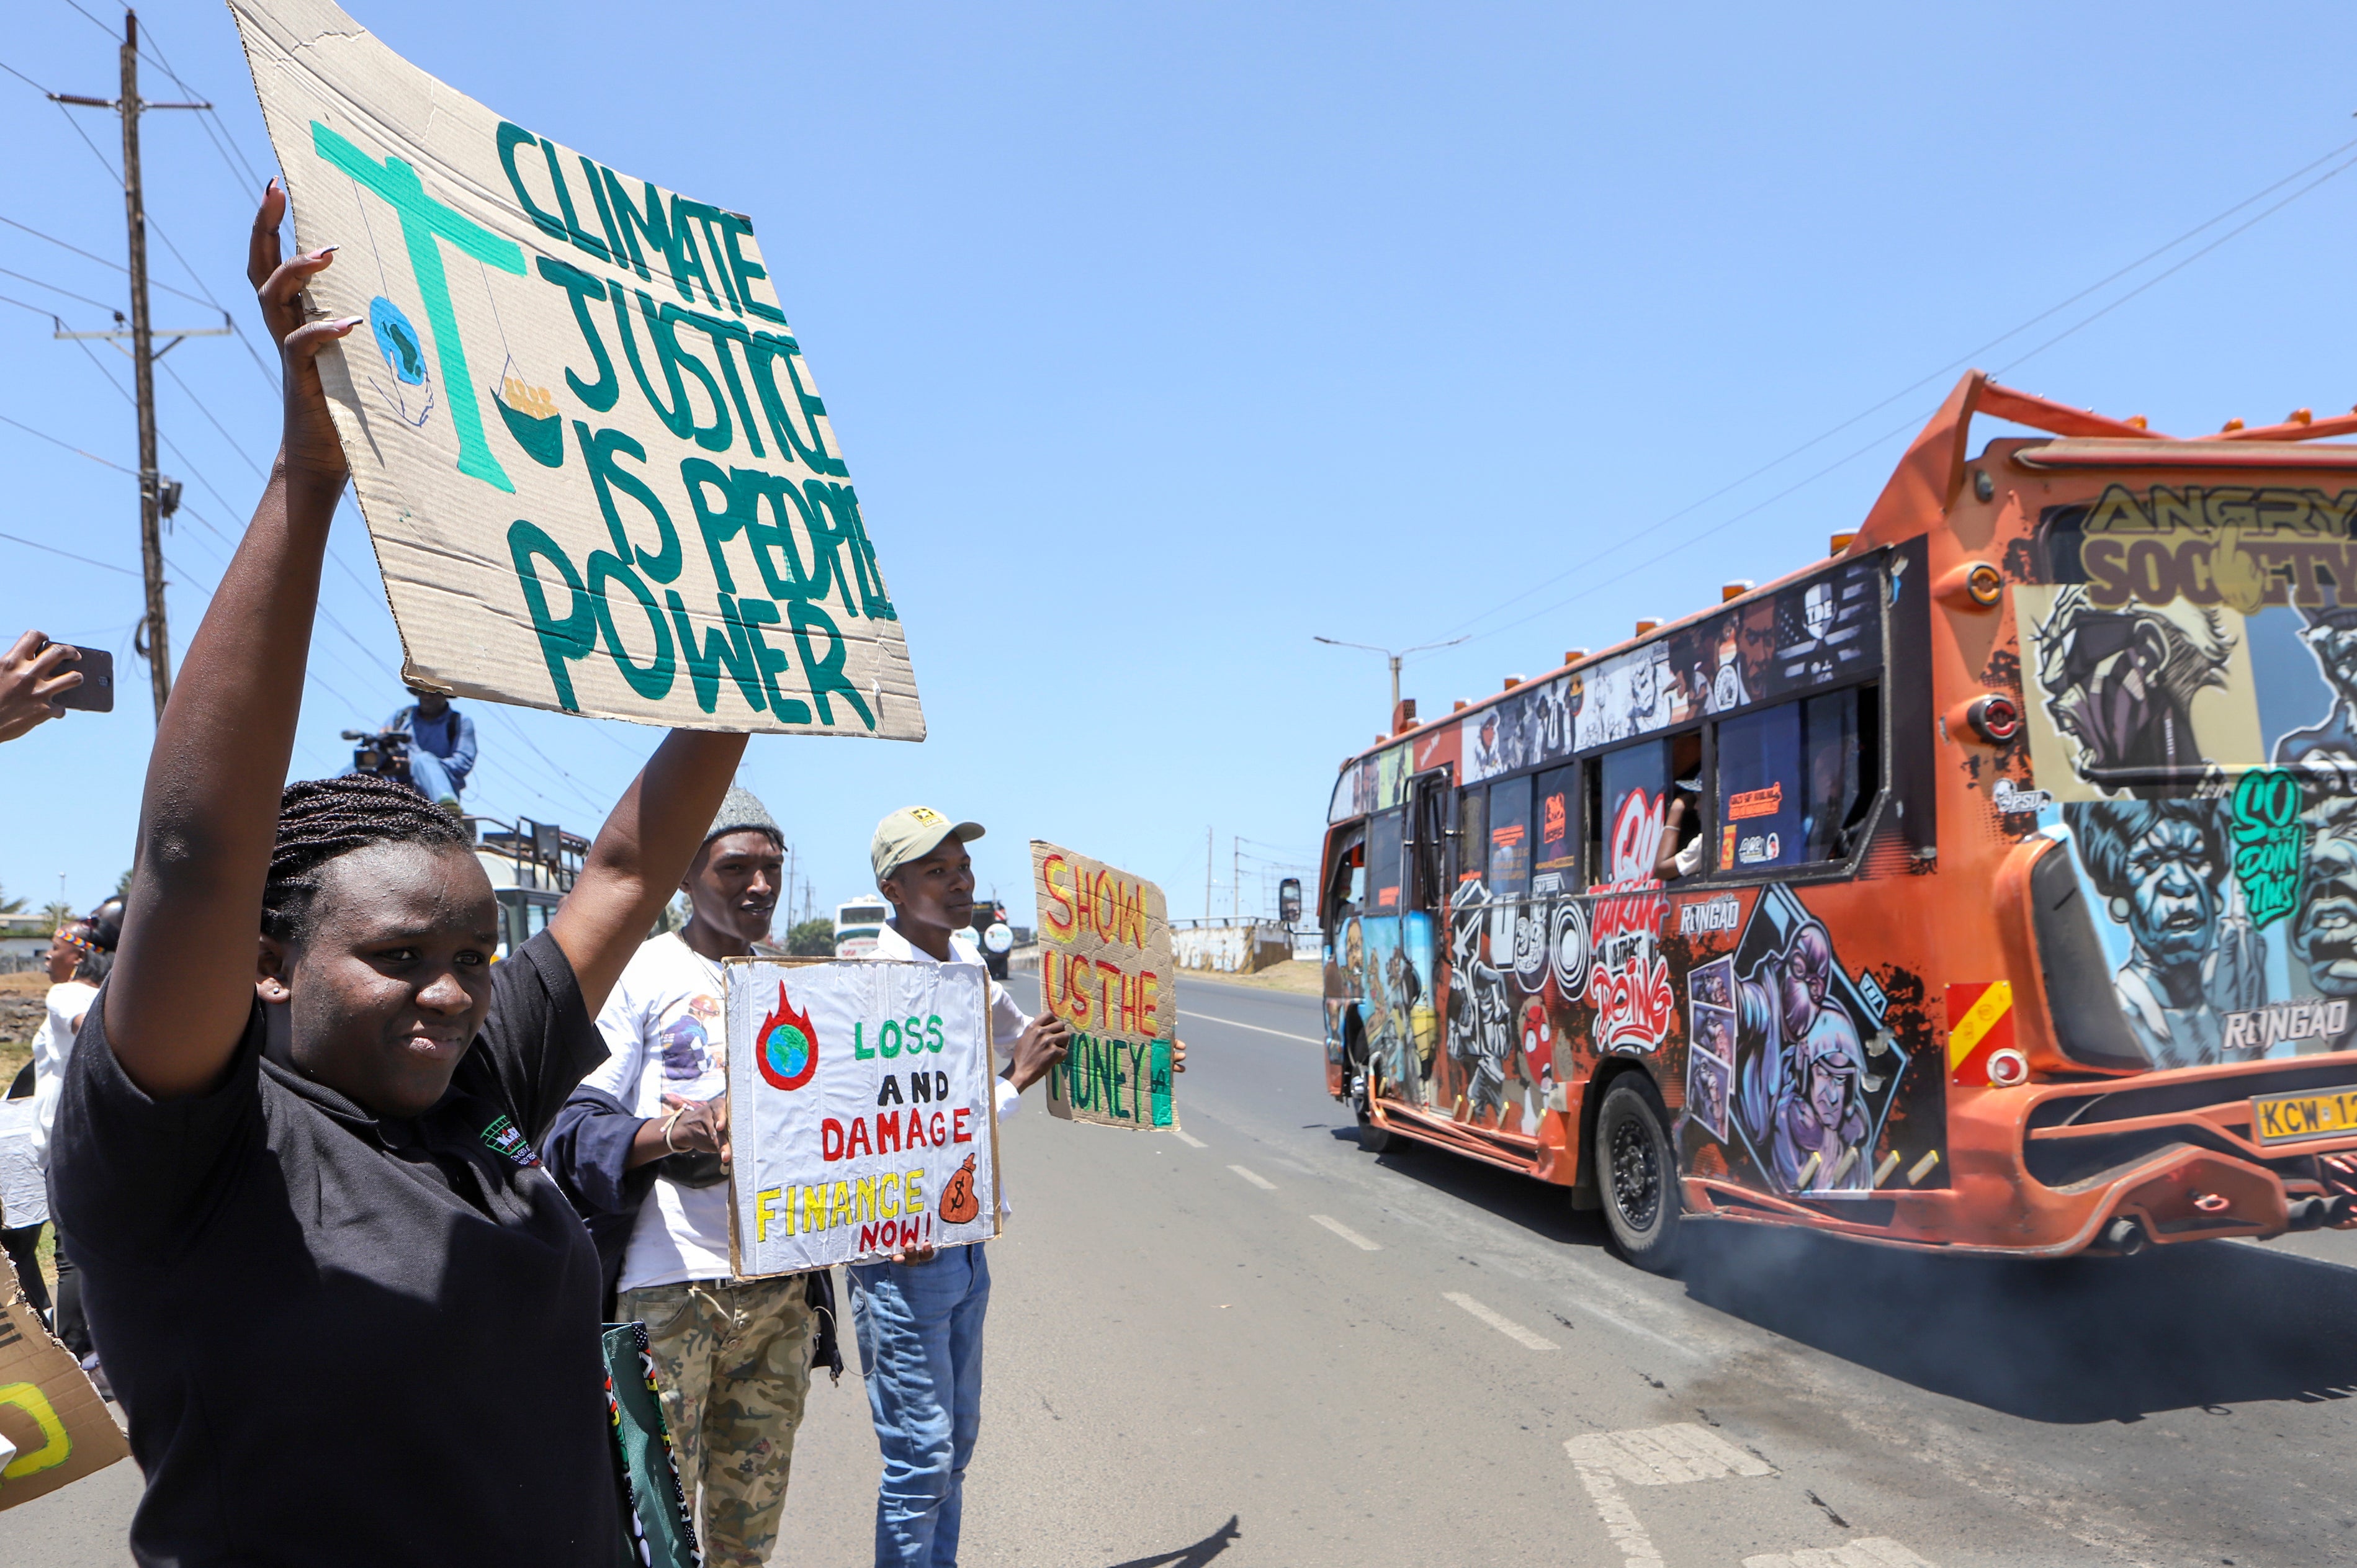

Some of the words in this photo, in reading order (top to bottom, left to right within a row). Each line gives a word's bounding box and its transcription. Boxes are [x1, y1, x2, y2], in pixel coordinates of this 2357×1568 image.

[496, 121, 788, 326] CLIMATE
[536, 255, 851, 477] JUSTICE
[572, 419, 683, 584] IS
[680, 457, 897, 620] PEOPLE
[2082, 483, 2357, 537] ANGRY
[506, 519, 876, 732] POWER
[2235, 771, 2296, 843] SO
[1043, 854, 1147, 950] SHOW
[1044, 949, 1093, 1030] US
[1095, 959, 1158, 1037] THE
[855, 1014, 944, 1060] LOSS
[878, 1070, 948, 1106] AND
[1051, 1032, 1148, 1124] MONEY
[821, 1107, 972, 1162] DAMAGE
[2263, 1100, 2319, 1134] KCW
[755, 1168, 925, 1243] FINANCE
[859, 1212, 932, 1252] NOW!
